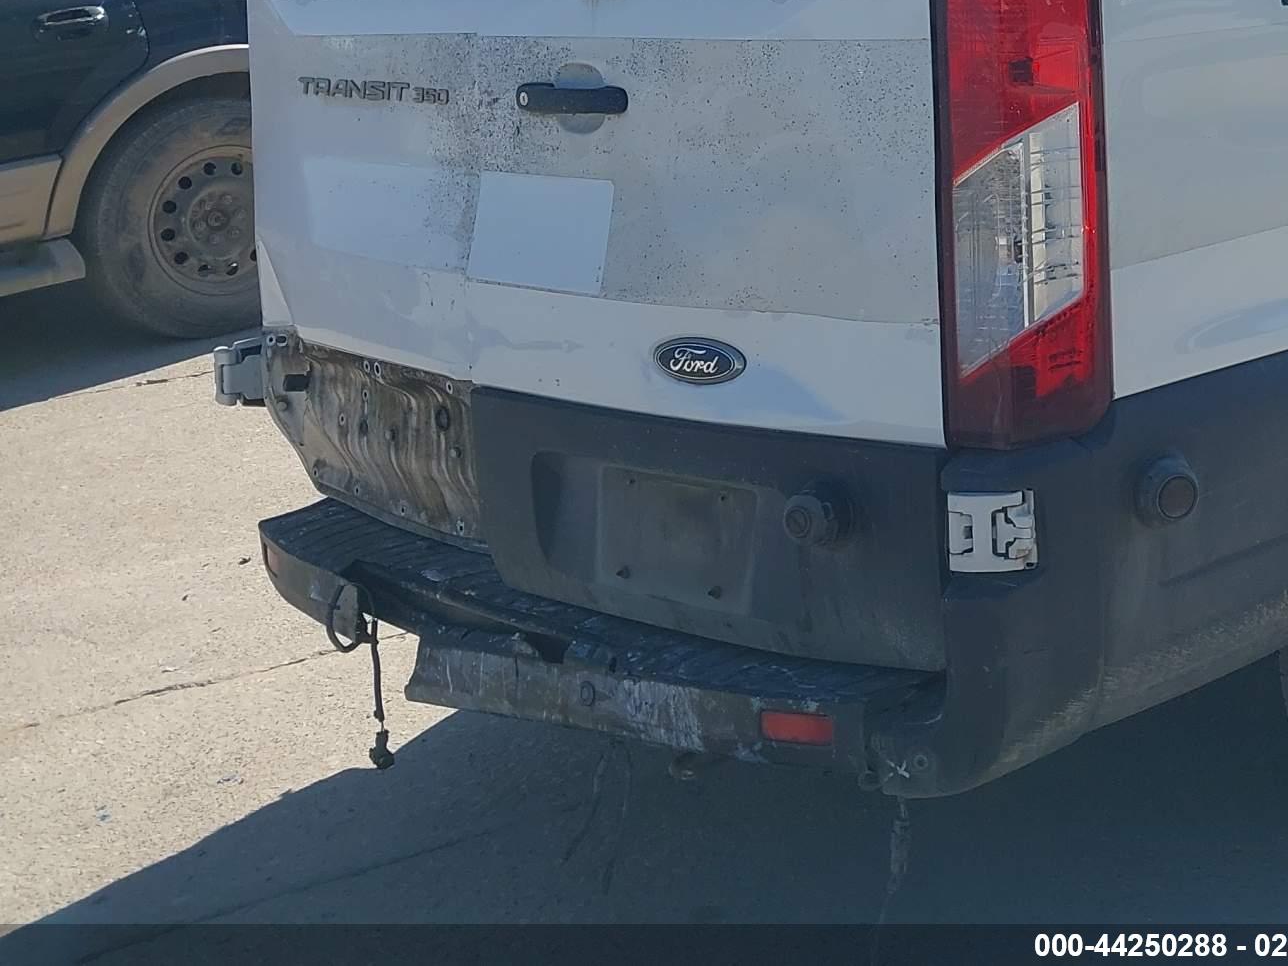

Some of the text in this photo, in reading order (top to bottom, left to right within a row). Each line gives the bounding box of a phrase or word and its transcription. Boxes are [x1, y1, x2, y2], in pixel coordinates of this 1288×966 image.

[298, 76, 450, 106] TRANSIT 350
[669, 347, 719, 374] Ford
